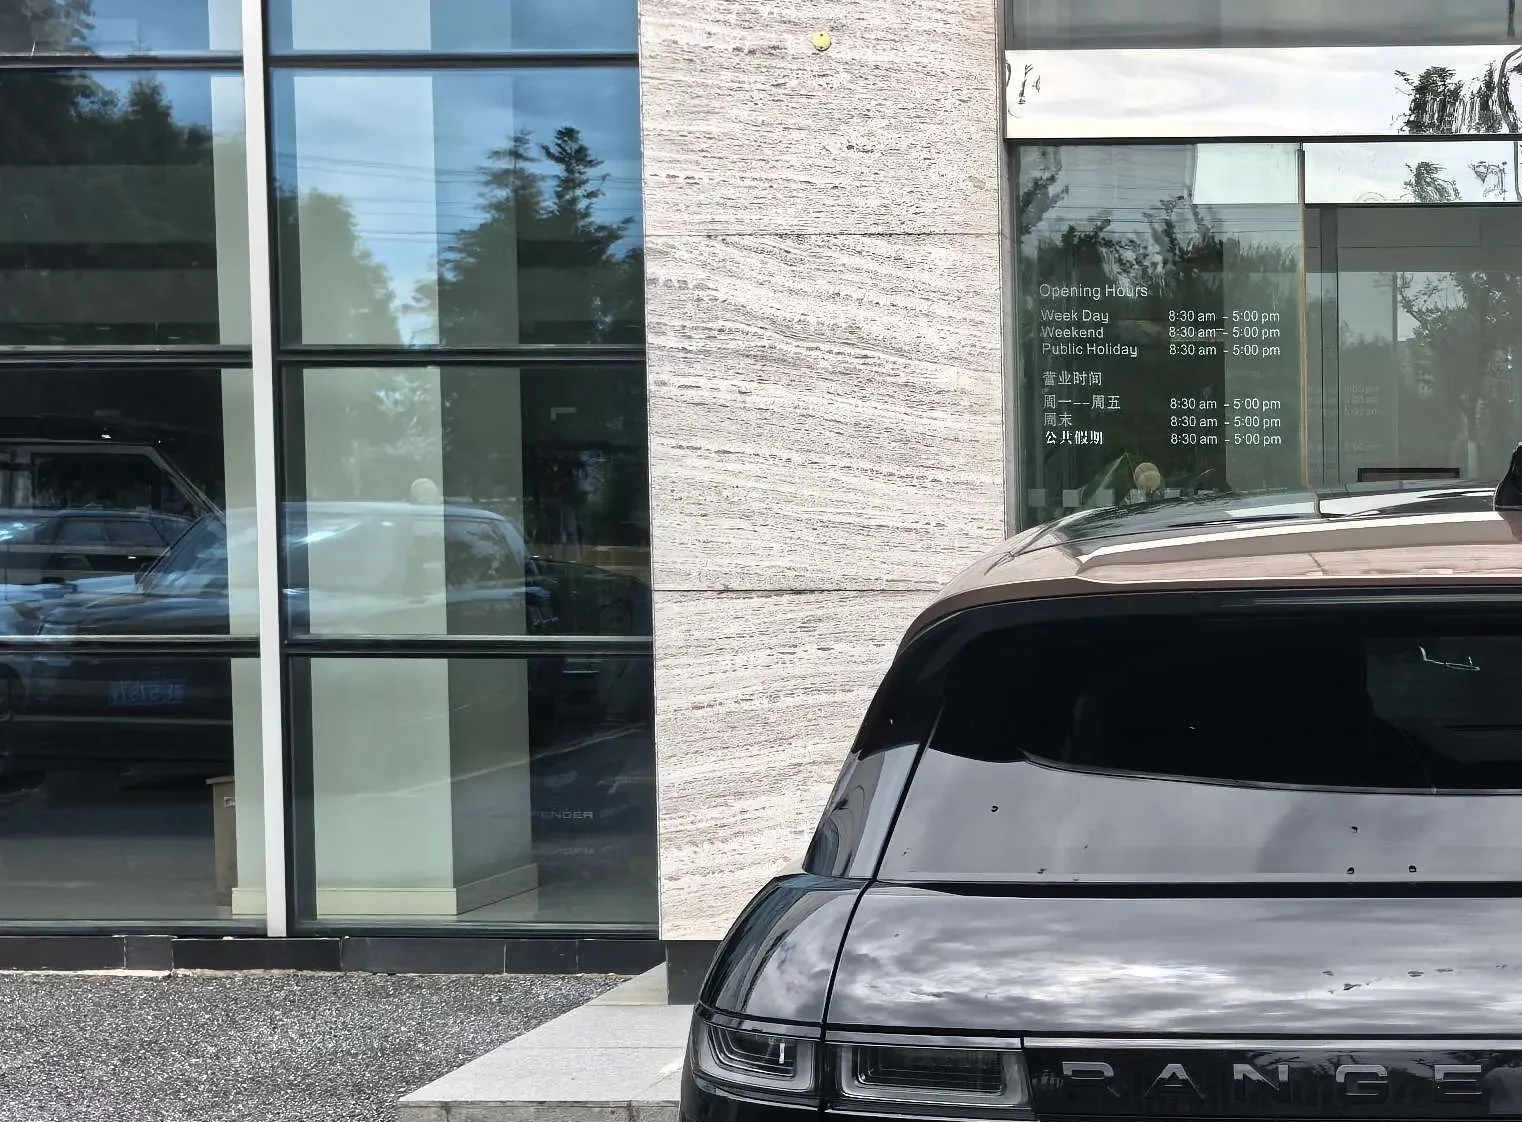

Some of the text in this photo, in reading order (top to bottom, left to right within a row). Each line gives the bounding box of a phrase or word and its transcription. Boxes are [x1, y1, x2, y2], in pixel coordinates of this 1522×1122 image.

[1039, 284, 1148, 300] Opening Hours
[1041, 310, 1109, 323] Week Day
[1168, 310, 1195, 322] 8:30
[1197, 313, 1216, 322] am
[1232, 310, 1258, 322] 5:00
[1262, 313, 1280, 324] pm
[1041, 327, 1104, 338] Weekend
[1169, 327, 1195, 337] 8:30
[1233, 327, 1259, 337] 5:00
[1262, 330, 1280, 340] pm
[1042, 343, 1138, 357] Public Holiday
[1169, 345, 1195, 355] 8:30
[1233, 345, 1259, 355] 5:00
[1262, 348, 1281, 358] pm
[1043, 371, 1103, 386] 营业时间
[1170, 399, 1196, 409] 8:30
[1234, 399, 1259, 409] 5:00
[1263, 402, 1281, 412] pm
[1043, 412, 1073, 427] 周末
[1170, 416, 1196, 426] 8:30
[1234, 416, 1260, 426] 5:00
[1263, 419, 1281, 429] pm
[1045, 431, 1103, 445] 公共假期
[1170, 434, 1196, 444] 8:30
[1234, 434, 1260, 444] 5:00
[1263, 437, 1282, 447] pm
[1062, 1061, 1484, 1104] RANGE
